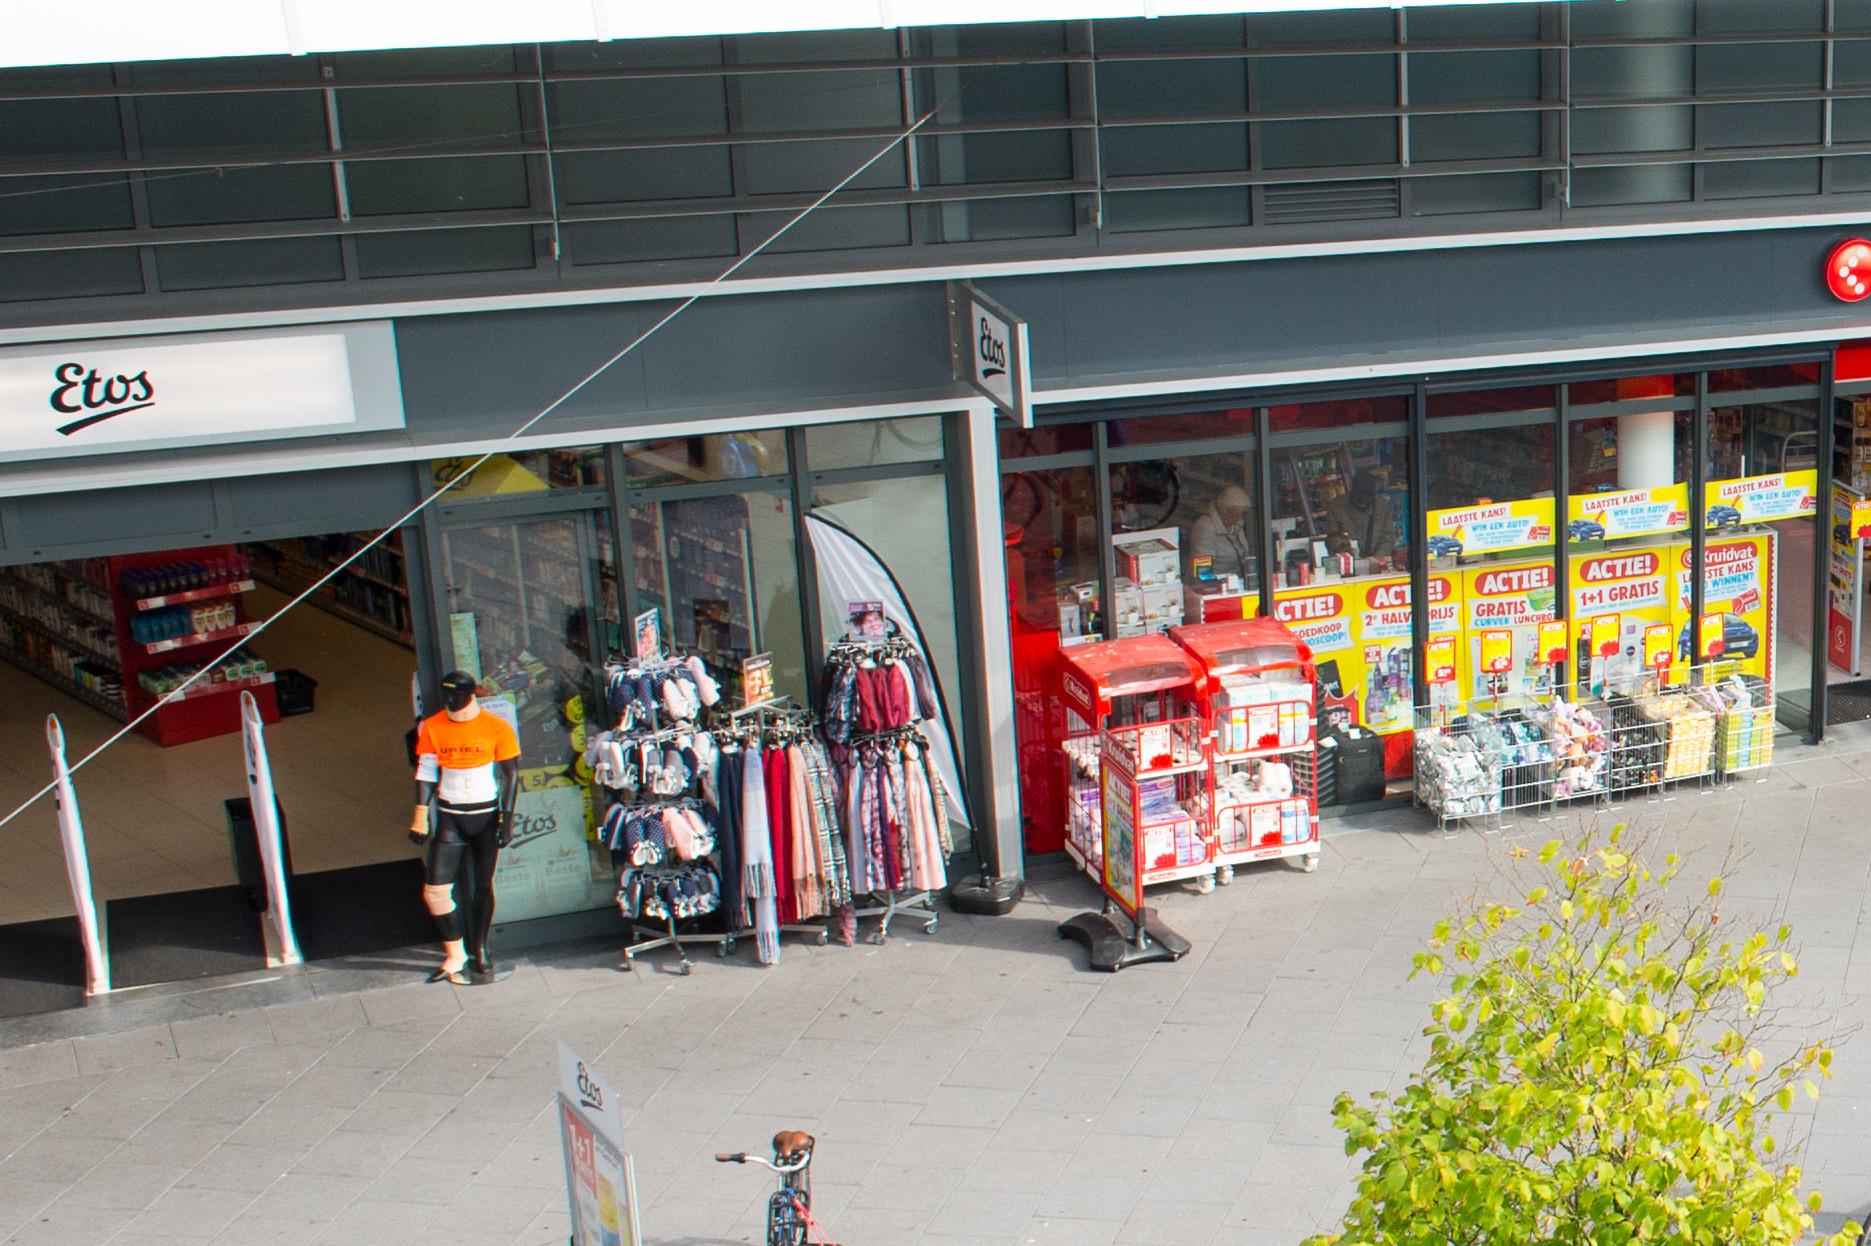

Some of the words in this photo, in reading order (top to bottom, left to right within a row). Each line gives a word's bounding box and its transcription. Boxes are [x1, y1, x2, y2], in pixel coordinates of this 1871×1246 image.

[981, 317, 1005, 368] Etos
[50, 362, 154, 413] Etos
[1723, 482, 1755, 496] LAATSTE
[1757, 477, 1781, 490] KANS!
[1585, 498, 1620, 510] LAATSTE
[1623, 493, 1647, 505] KANS!
[1442, 511, 1478, 526] LAATSTE
[1481, 507, 1506, 521] KANS!
[1586, 554, 1652, 581] ACTIE!
[1727, 560, 1755, 575] KANS
[1482, 567, 1550, 594] ACTIE!
[1373, 580, 1444, 607] ACTE!
[1580, 590, 1603, 606] 1+1
[1608, 581, 1659, 601] GRATIS
[1275, 595, 1335, 621] CTIE!
[1382, 610, 1413, 624] HALV
[1427, 606, 1454, 621] RIJS
[1474, 617, 1510, 627] CURVER
[1513, 613, 1554, 624] LUNCHBO
[1475, 600, 1527, 617] GRATIS
[578, 1060, 603, 1106] Etos
